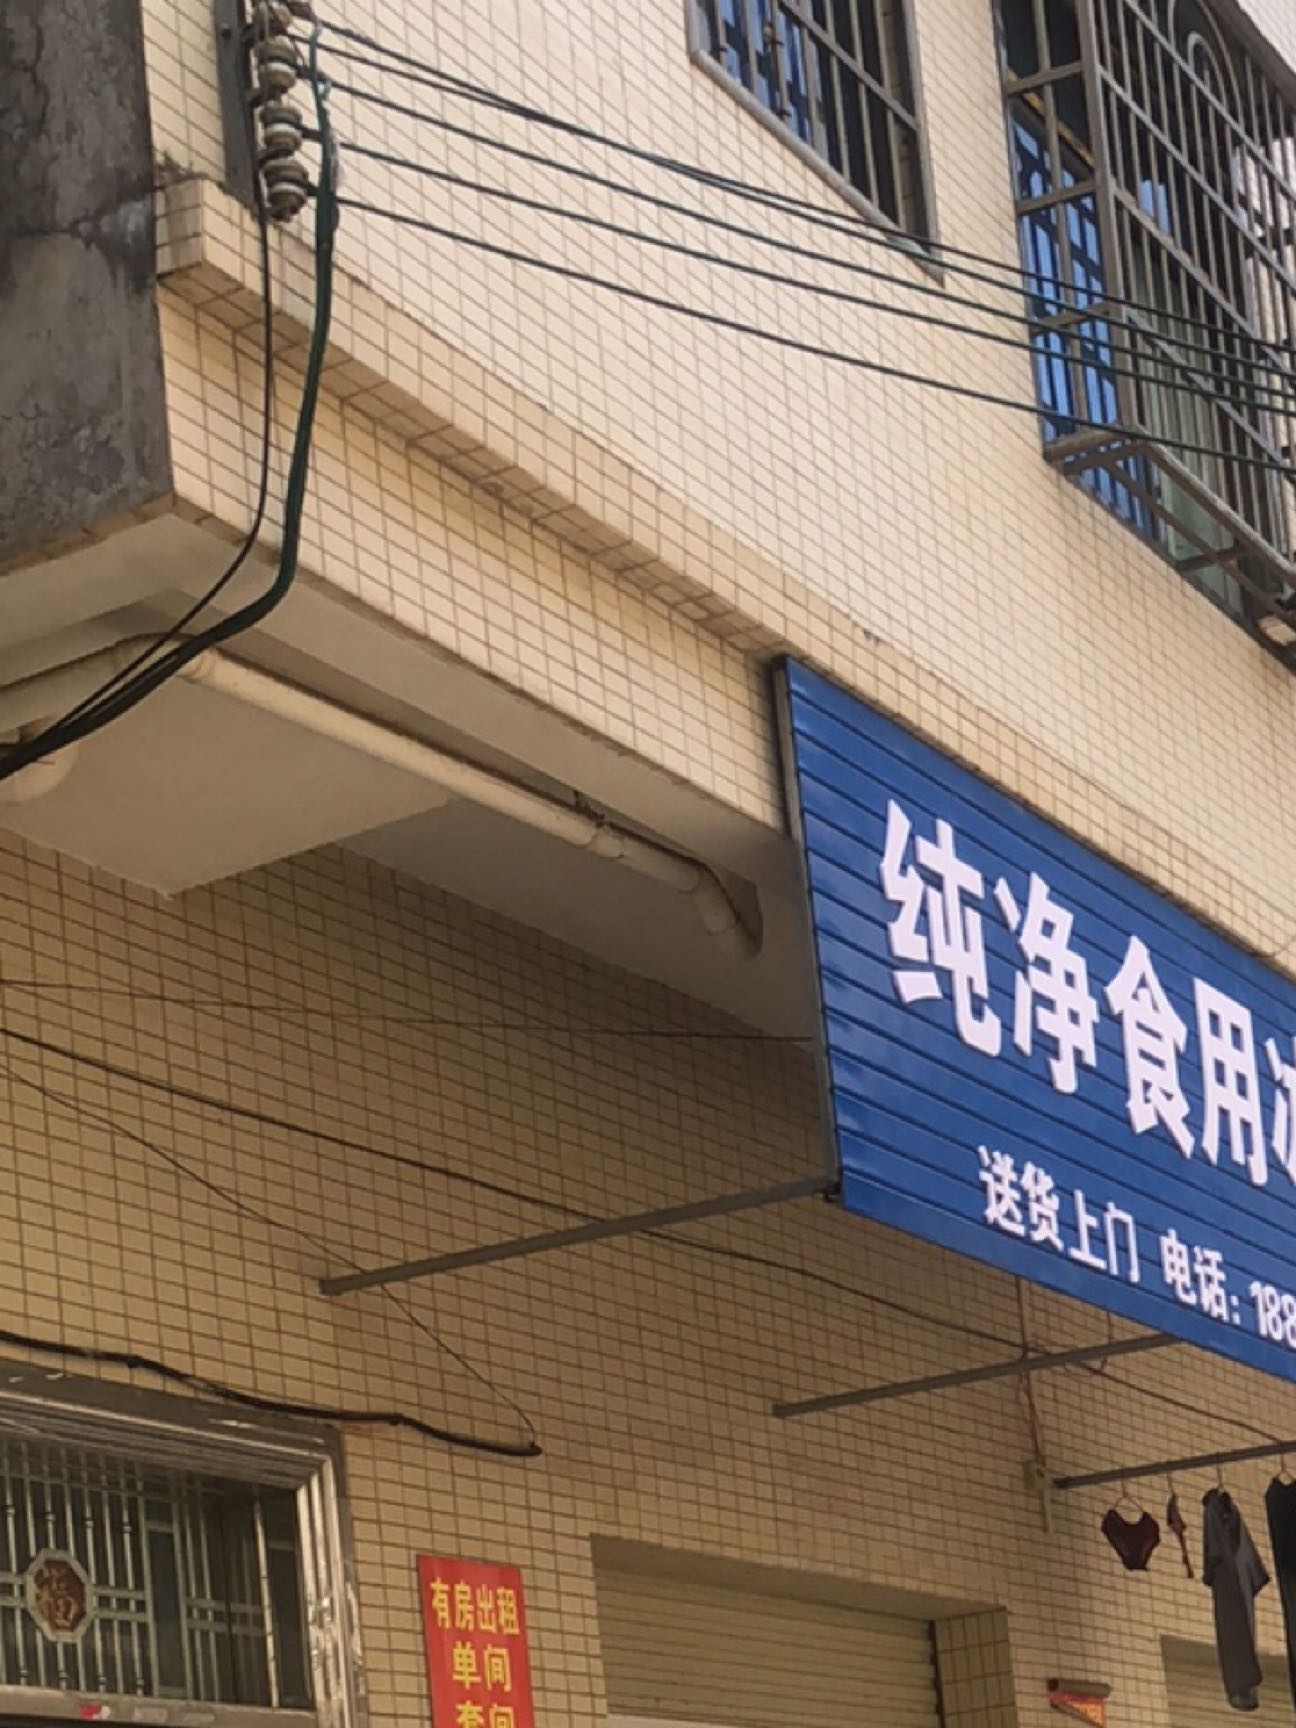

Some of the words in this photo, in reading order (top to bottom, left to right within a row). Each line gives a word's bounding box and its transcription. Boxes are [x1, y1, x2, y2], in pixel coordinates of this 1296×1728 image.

[977, 1144, 1140, 1284] 送货上门
[430, 1577, 520, 1636] 有房出租
[452, 1641, 512, 1692] 单间
